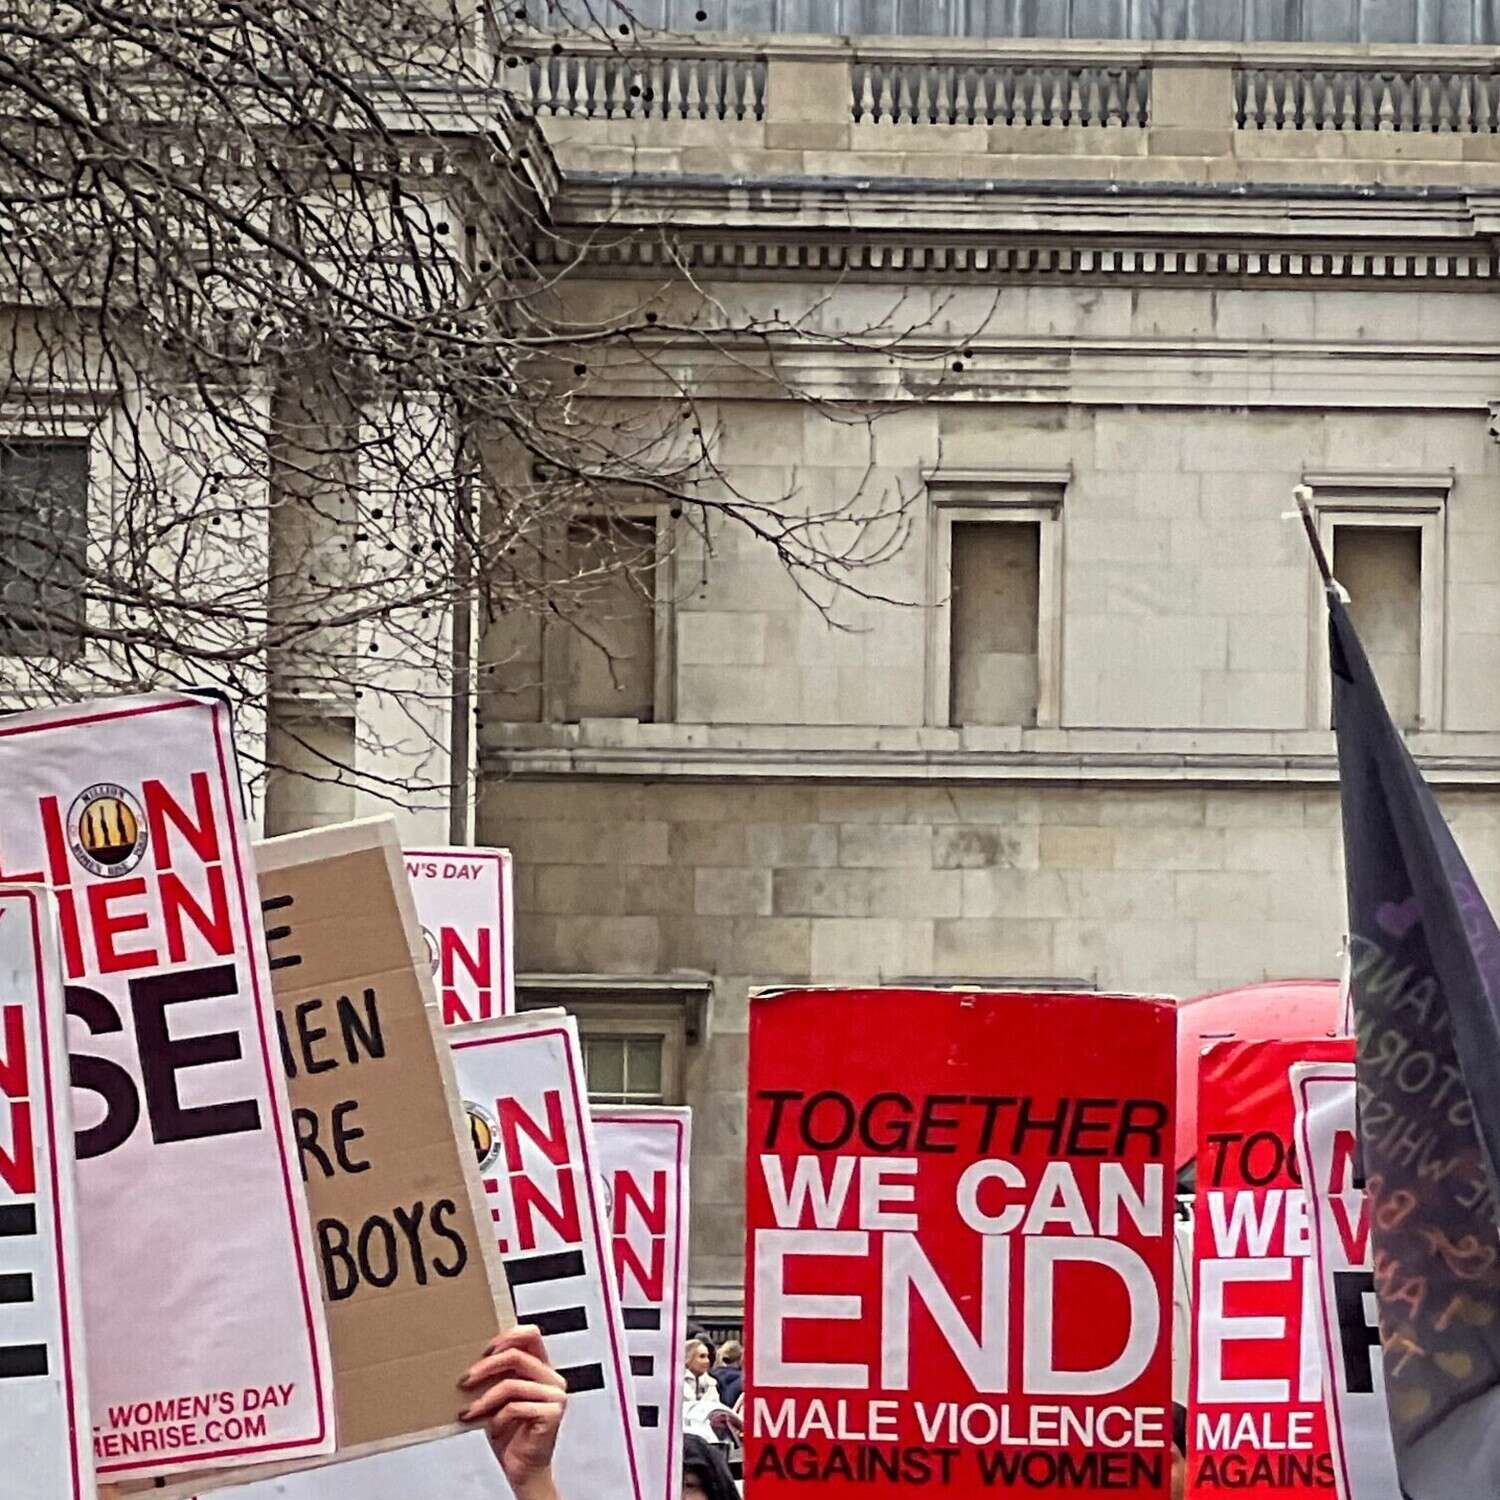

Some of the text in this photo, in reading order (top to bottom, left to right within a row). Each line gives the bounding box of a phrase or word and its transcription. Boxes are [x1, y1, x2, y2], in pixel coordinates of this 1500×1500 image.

[443, 864, 484, 880] DAY
[756, 1089, 1168, 1157] TOGETHER
[760, 1153, 1163, 1238] WE CAN
[318, 1198, 468, 1300] BOYS
[752, 1227, 1161, 1397] END
[109, 1383, 295, 1429] WOMEN'S DAY
[752, 1397, 1165, 1449] MALE VIOLENCE
[1195, 1411, 1313, 1451] MALE
[753, 1443, 1164, 1490] AGAINST WOMEN
